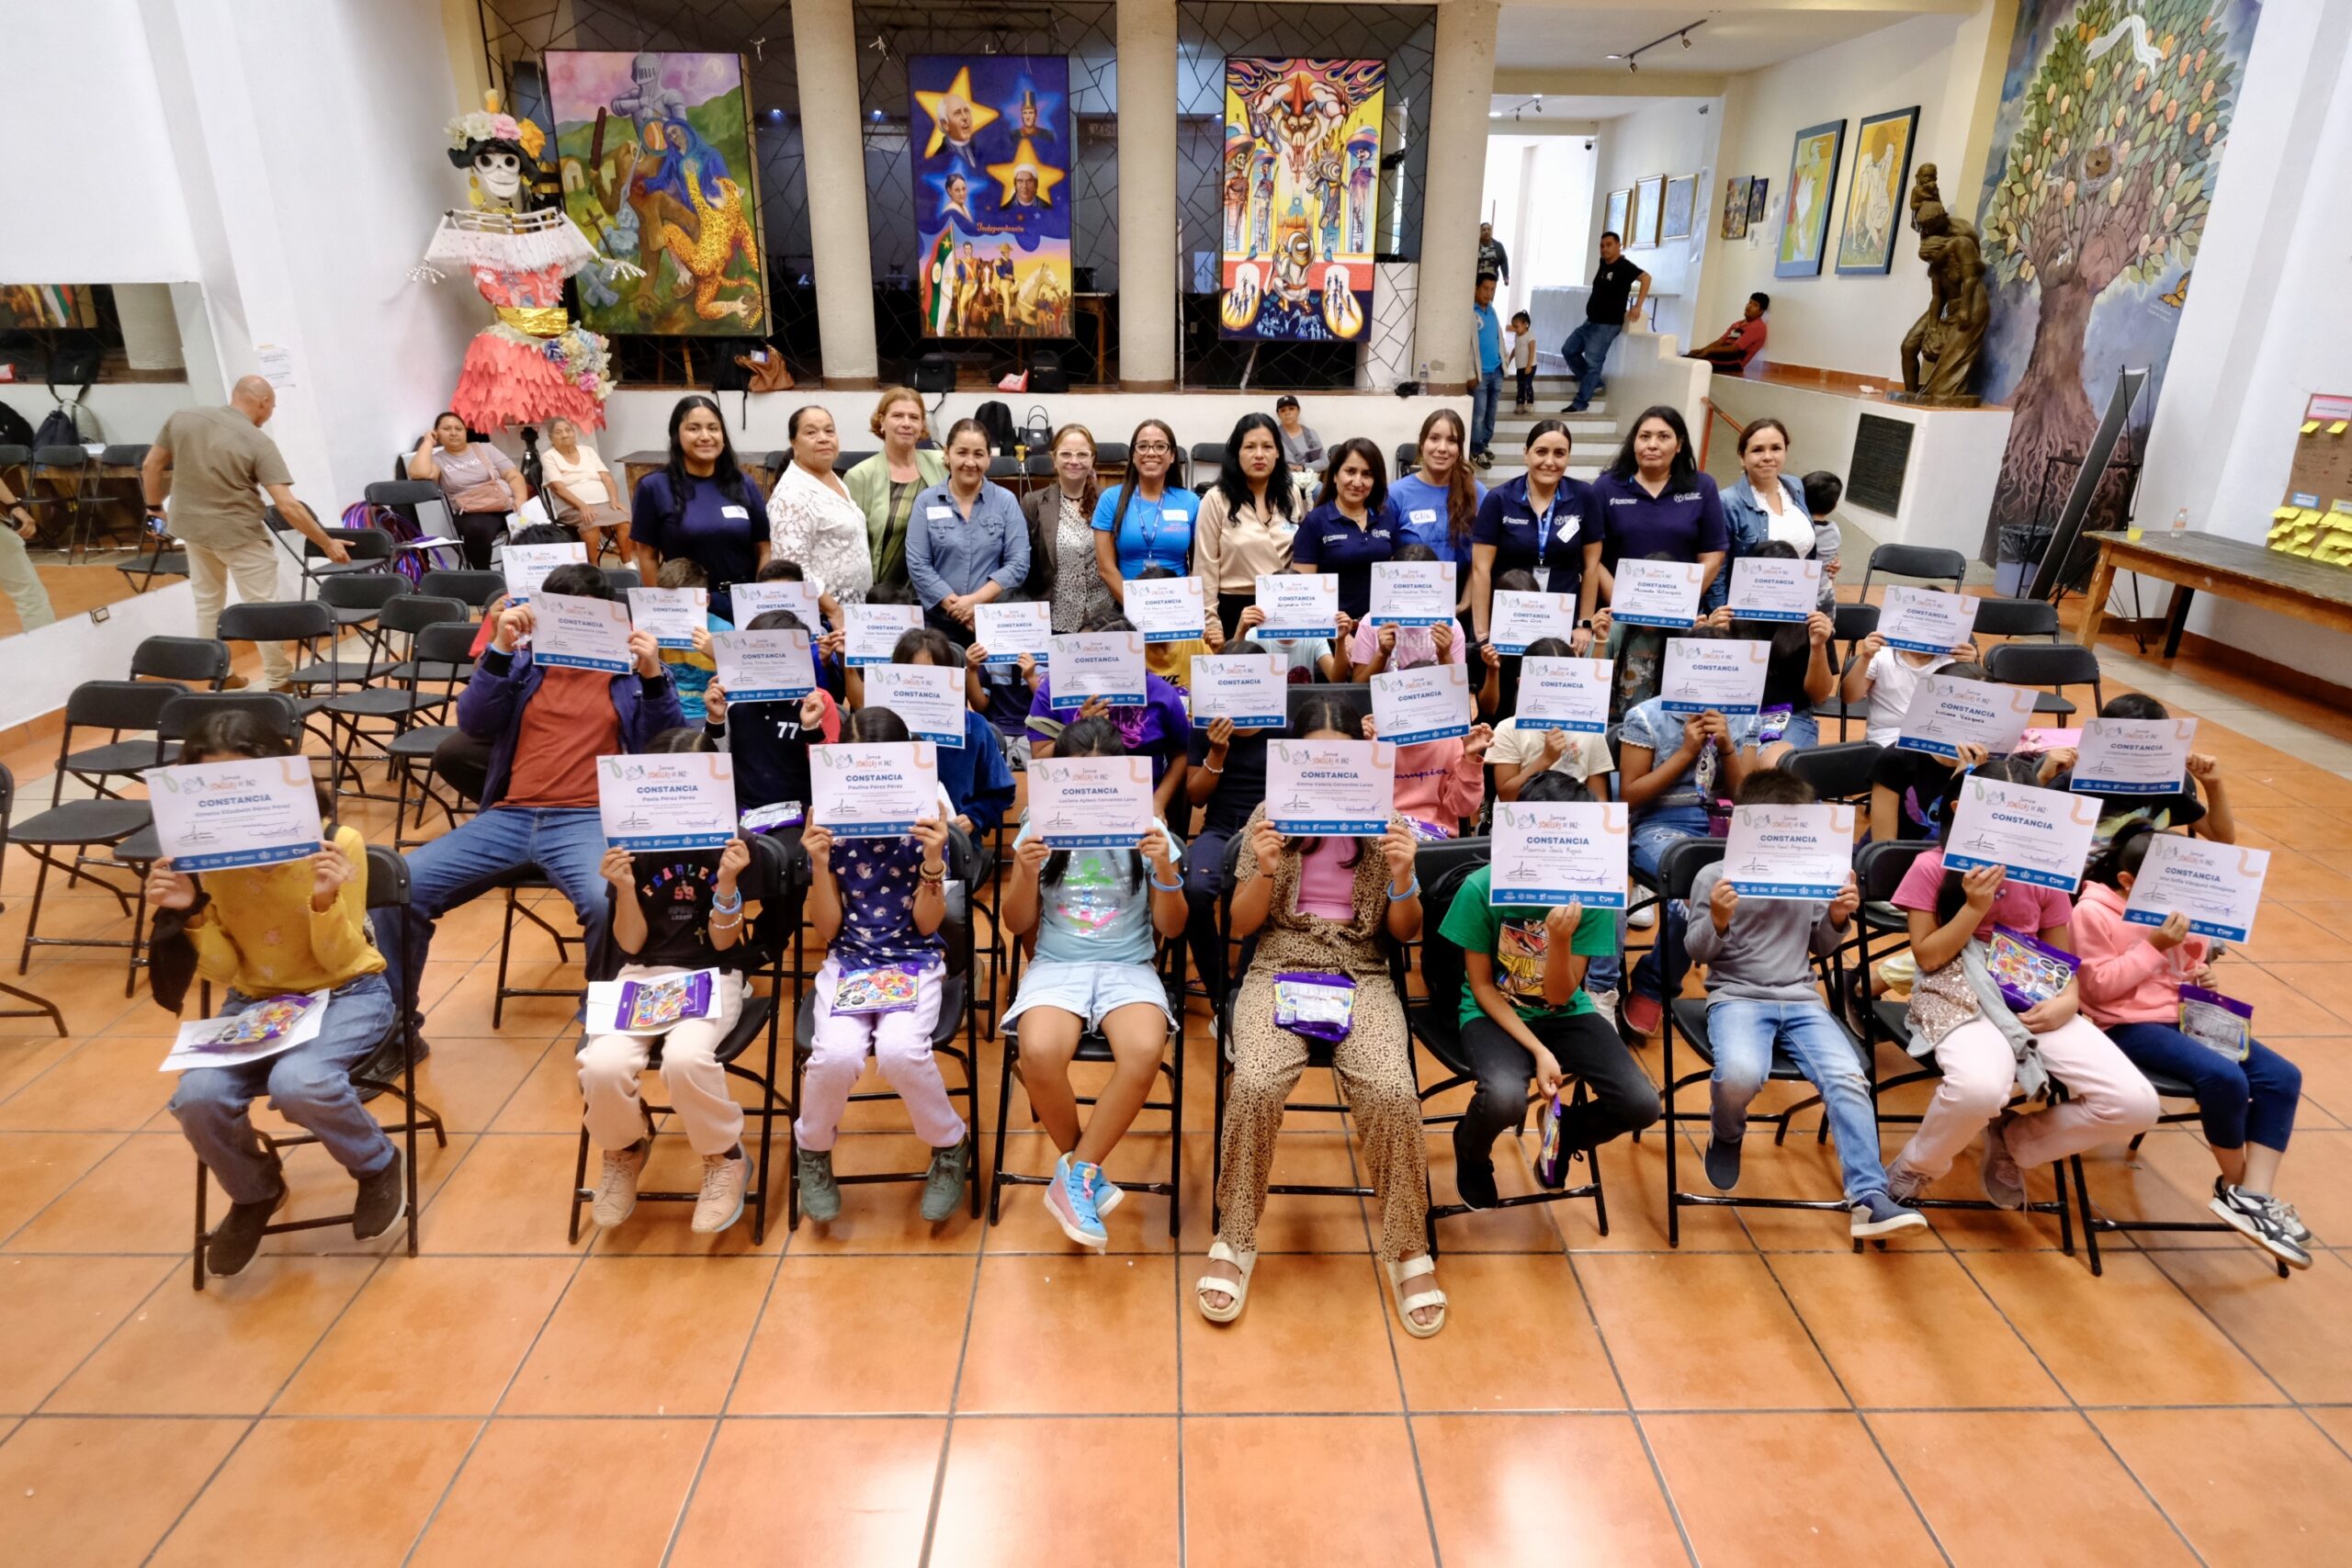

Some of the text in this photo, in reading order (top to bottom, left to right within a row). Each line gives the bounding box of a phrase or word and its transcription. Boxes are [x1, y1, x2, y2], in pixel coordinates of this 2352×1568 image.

[1636, 581, 1678, 590] CONSTANCIA
[1905, 608, 1949, 620] CONSTANCIA
[558, 617, 604, 628] CONSTANCIA
[1540, 681, 1584, 689] CONSTANCIA
[893, 691, 941, 699] CONSTANCIA
[1397, 691, 1442, 702] CONSTANCIA
[1940, 702, 1996, 718] CONSTANCIA
[776, 721, 799, 739] 77
[845, 773, 903, 782] CONSTANCIA
[1395, 768, 1450, 782] ampion
[637, 784, 698, 794] CONSTANCIA
[1062, 787, 1118, 795] CONSTANCIA
[198, 794, 273, 808] CONSTANCIA
[1991, 812, 2053, 830] CONSTANCIA
[1526, 836, 1589, 845] CONSTANCIA
[1760, 834, 1817, 843] CONSTANCIA
[2165, 866, 2221, 883] CONSTANCIA
